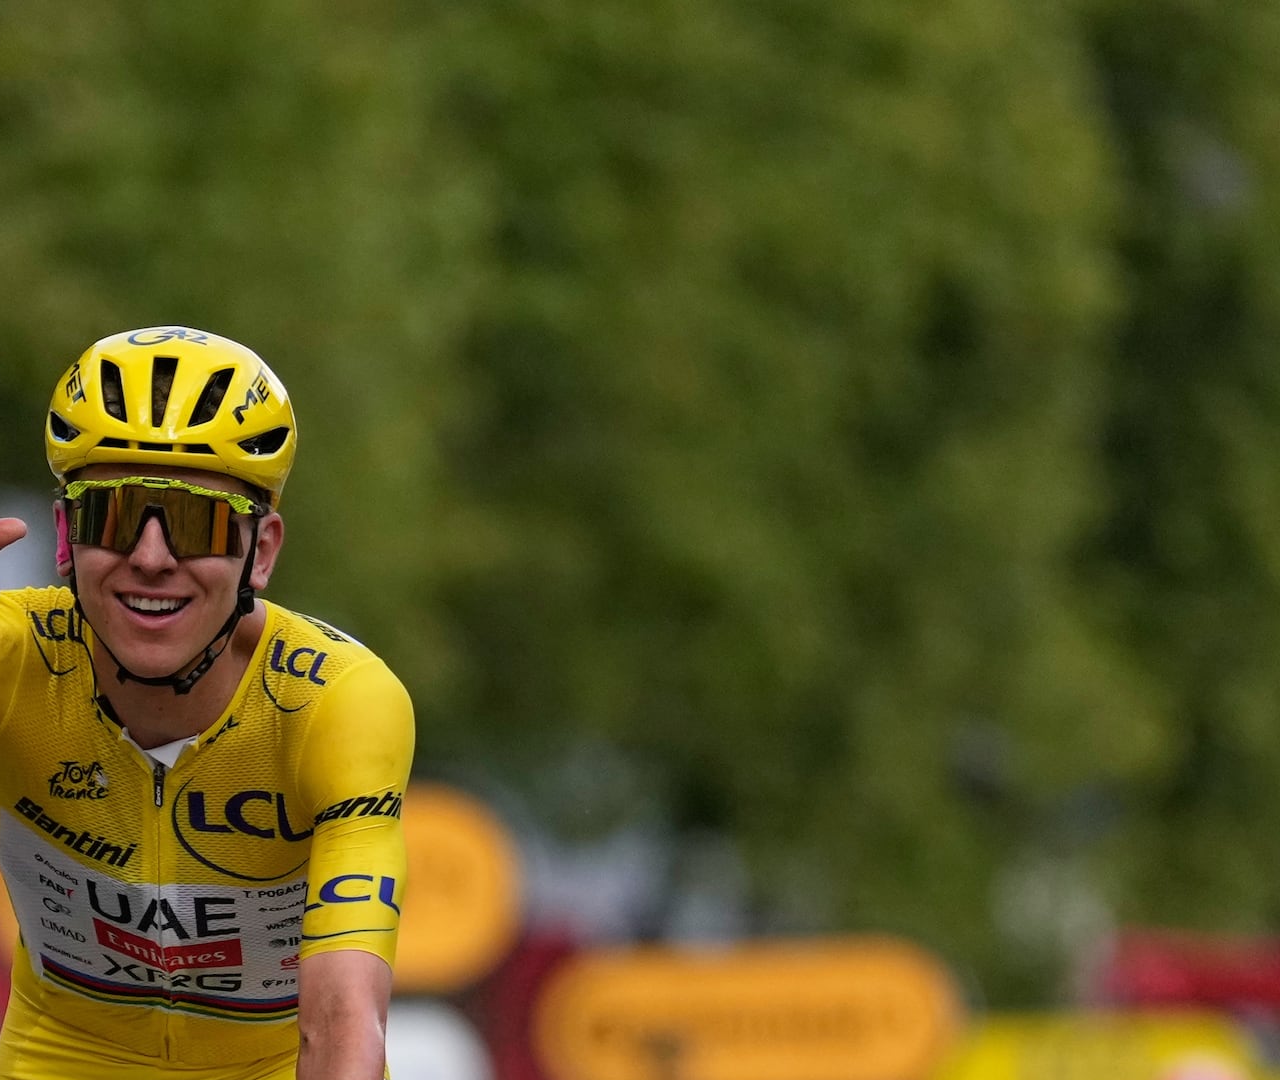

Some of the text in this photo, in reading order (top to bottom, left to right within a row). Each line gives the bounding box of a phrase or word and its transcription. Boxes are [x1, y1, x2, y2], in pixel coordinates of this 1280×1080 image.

[270, 639, 328, 686] LCL
[187, 790, 314, 842] LCL
[86, 878, 241, 940] UAE
[106, 930, 227, 966] Emirates
[101, 953, 242, 993] XRG
